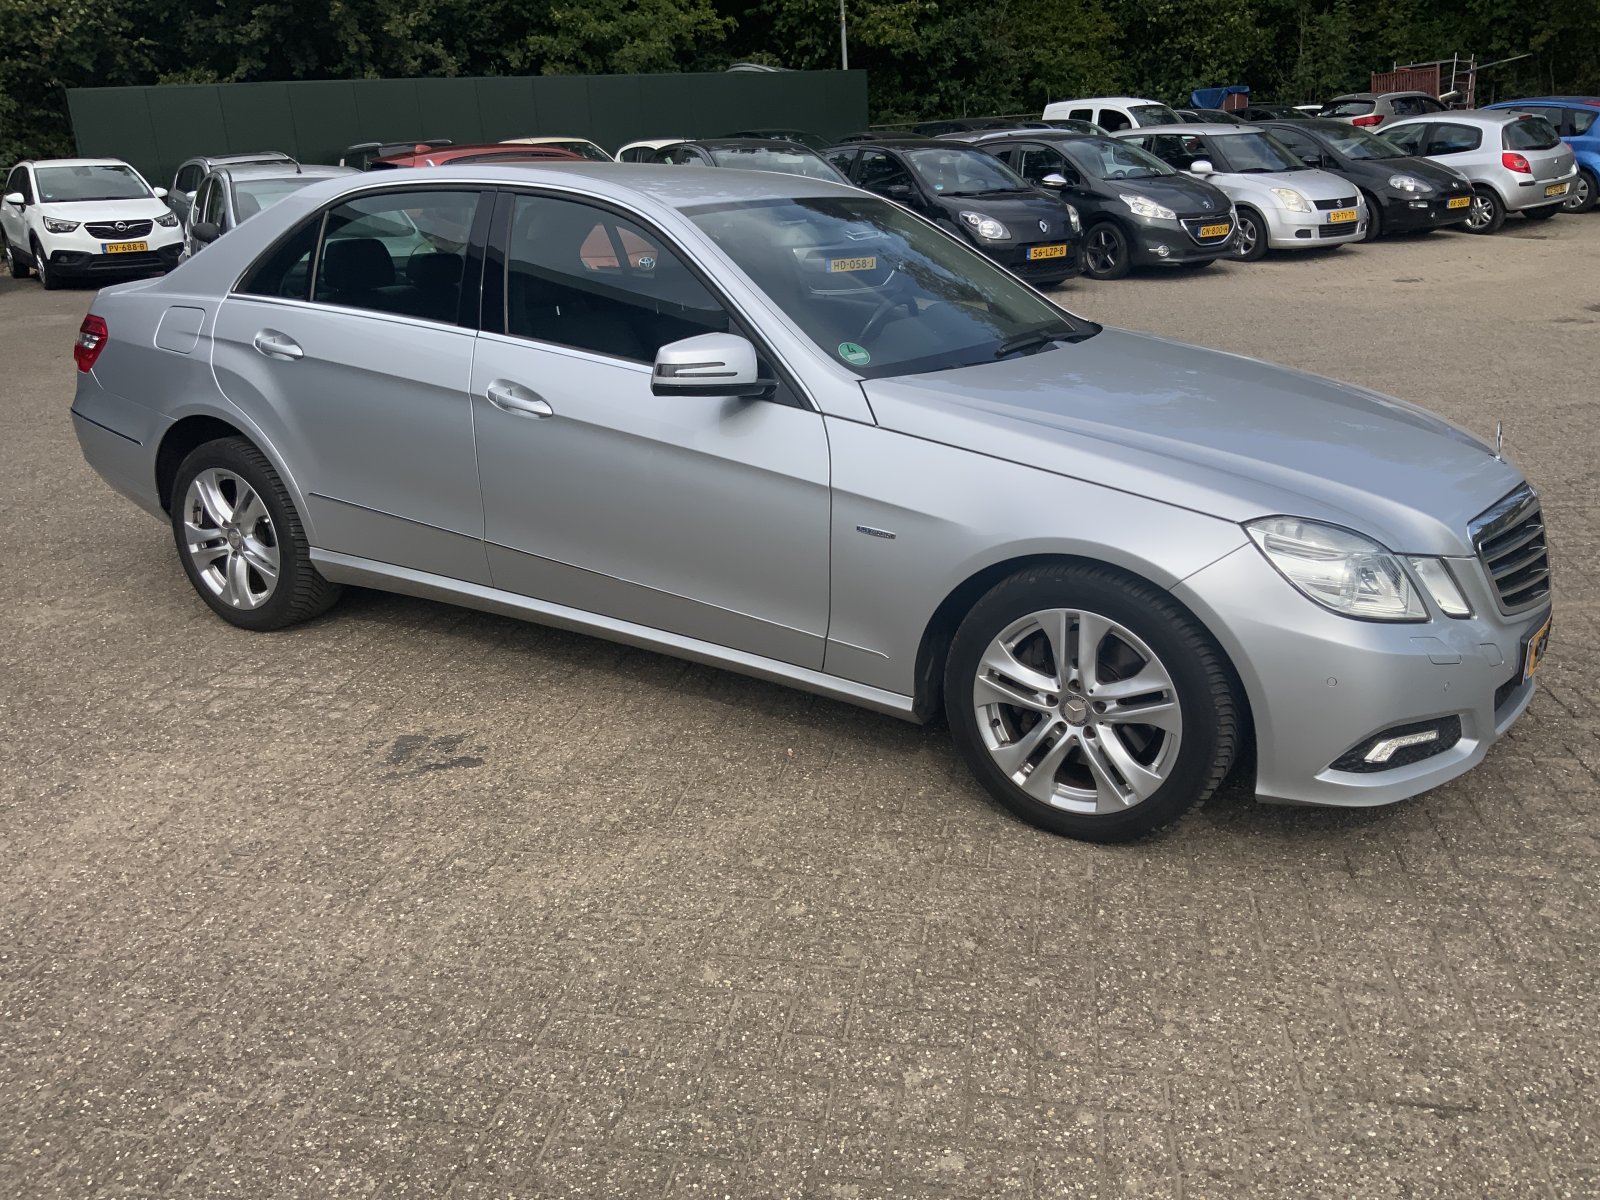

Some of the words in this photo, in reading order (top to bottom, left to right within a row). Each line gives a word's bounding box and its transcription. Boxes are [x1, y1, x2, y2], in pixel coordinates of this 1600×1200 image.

[108, 243, 145, 252] PV-688-B
[1033, 246, 1064, 258] 56-LZP-8
[833, 258, 874, 270] HD-058-J
